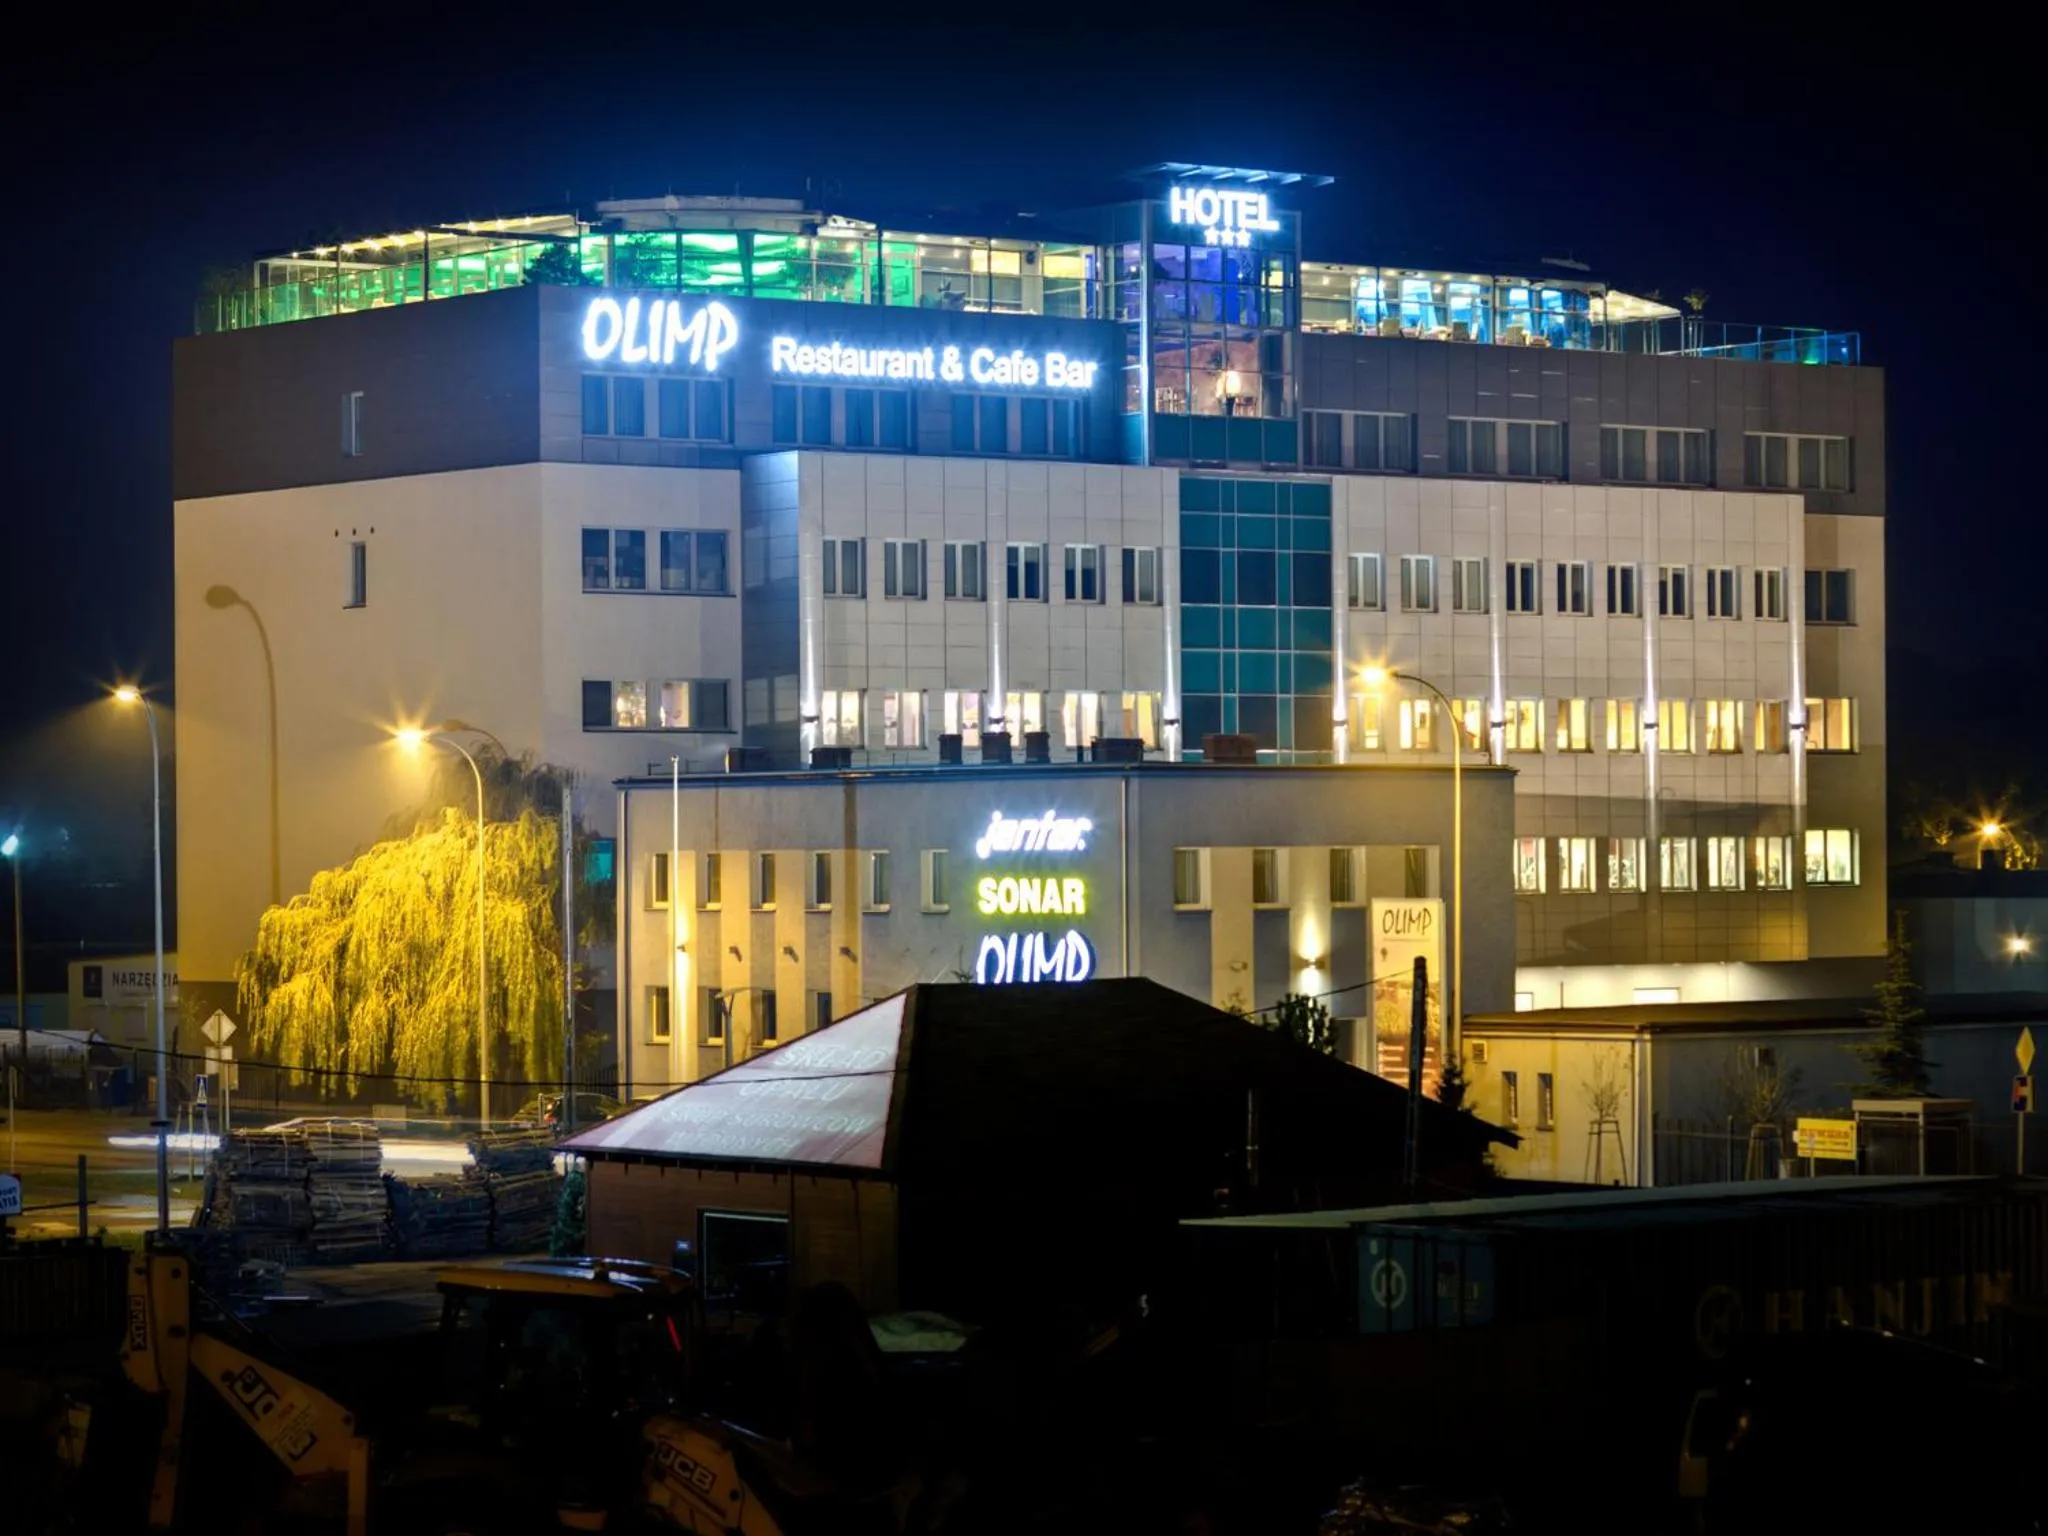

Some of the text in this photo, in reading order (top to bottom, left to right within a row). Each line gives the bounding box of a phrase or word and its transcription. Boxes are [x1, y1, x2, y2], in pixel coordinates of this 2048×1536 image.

[1170, 187, 1280, 231] HOTEL
[581, 296, 738, 371] OLIMP
[771, 335, 1098, 388] Restaurant & Cafe Bar
[977, 876, 1086, 915] SONAR
[1382, 907, 1432, 935] OLIMP
[657, 1442, 714, 1492] JCB
